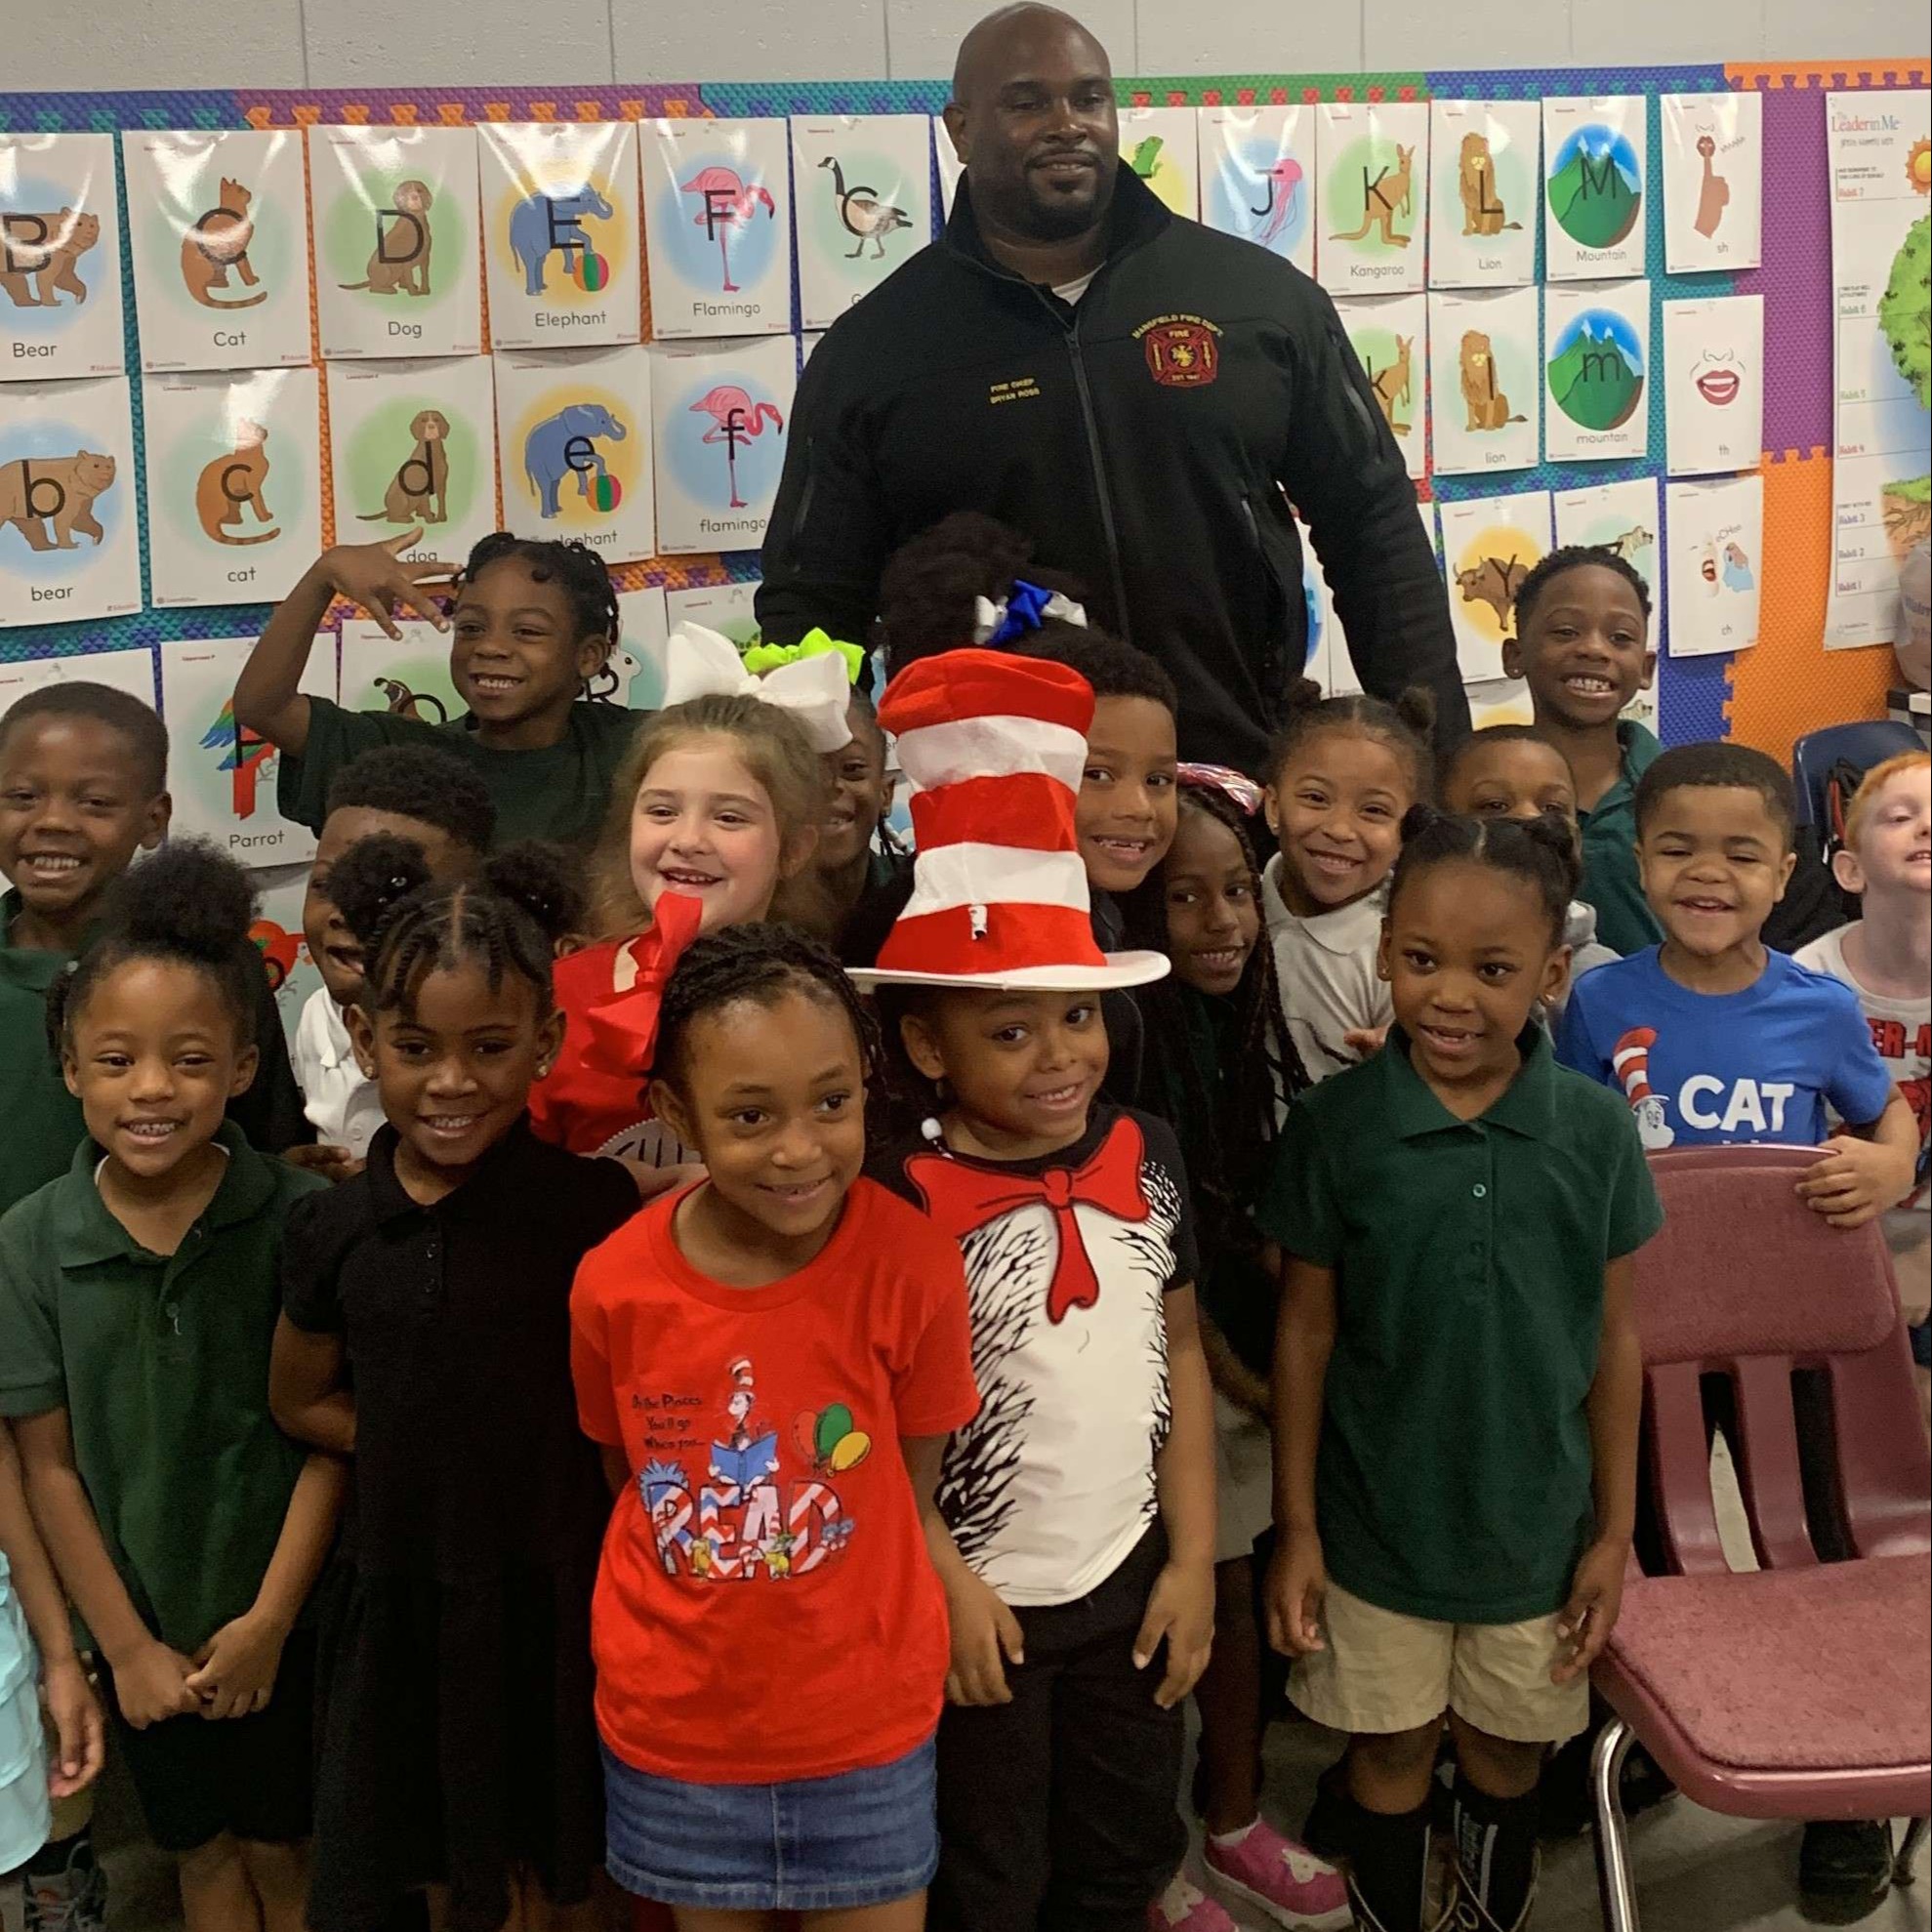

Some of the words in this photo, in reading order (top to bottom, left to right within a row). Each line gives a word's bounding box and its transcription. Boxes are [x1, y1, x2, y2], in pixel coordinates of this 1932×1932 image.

[1363, 165, 1393, 211] K
[1580, 156, 1617, 201] M
[1251, 168, 1285, 216] J
[1479, 170, 1504, 214] L
[546, 195, 585, 250] E
[705, 189, 736, 241] F
[195, 207, 248, 265] C
[376, 208, 425, 265] D
[1576, 248, 1627, 264] Mountain
[1717, 241, 1729, 254] sh
[1349, 264, 1405, 279] Kangaroo
[1478, 256, 1502, 270] Lion
[534, 309, 607, 330] Elephant
[692, 301, 761, 318] Flamingo
[212, 330, 248, 348] Cat
[388, 320, 423, 339] Dog
[13, 340, 58, 359] Bear
[1583, 352, 1621, 383] m
[721, 408, 745, 461] f
[1576, 432, 1628, 445] mountain
[563, 435, 596, 472] e
[1485, 451, 1506, 465] lion
[1718, 444, 1730, 457] th
[398, 440, 434, 498] d
[21, 460, 65, 519] b
[221, 464, 254, 503] c
[700, 516, 766, 534] flamingo
[553, 529, 618, 547] lephant
[226, 565, 257, 583] cat
[1488, 553, 1517, 598] Y
[31, 586, 74, 602] bear
[1721, 624, 1733, 637] ch
[229, 830, 285, 848] Parrot
[1678, 1074, 1795, 1132] CAT
[647, 1480, 844, 1581] READ
